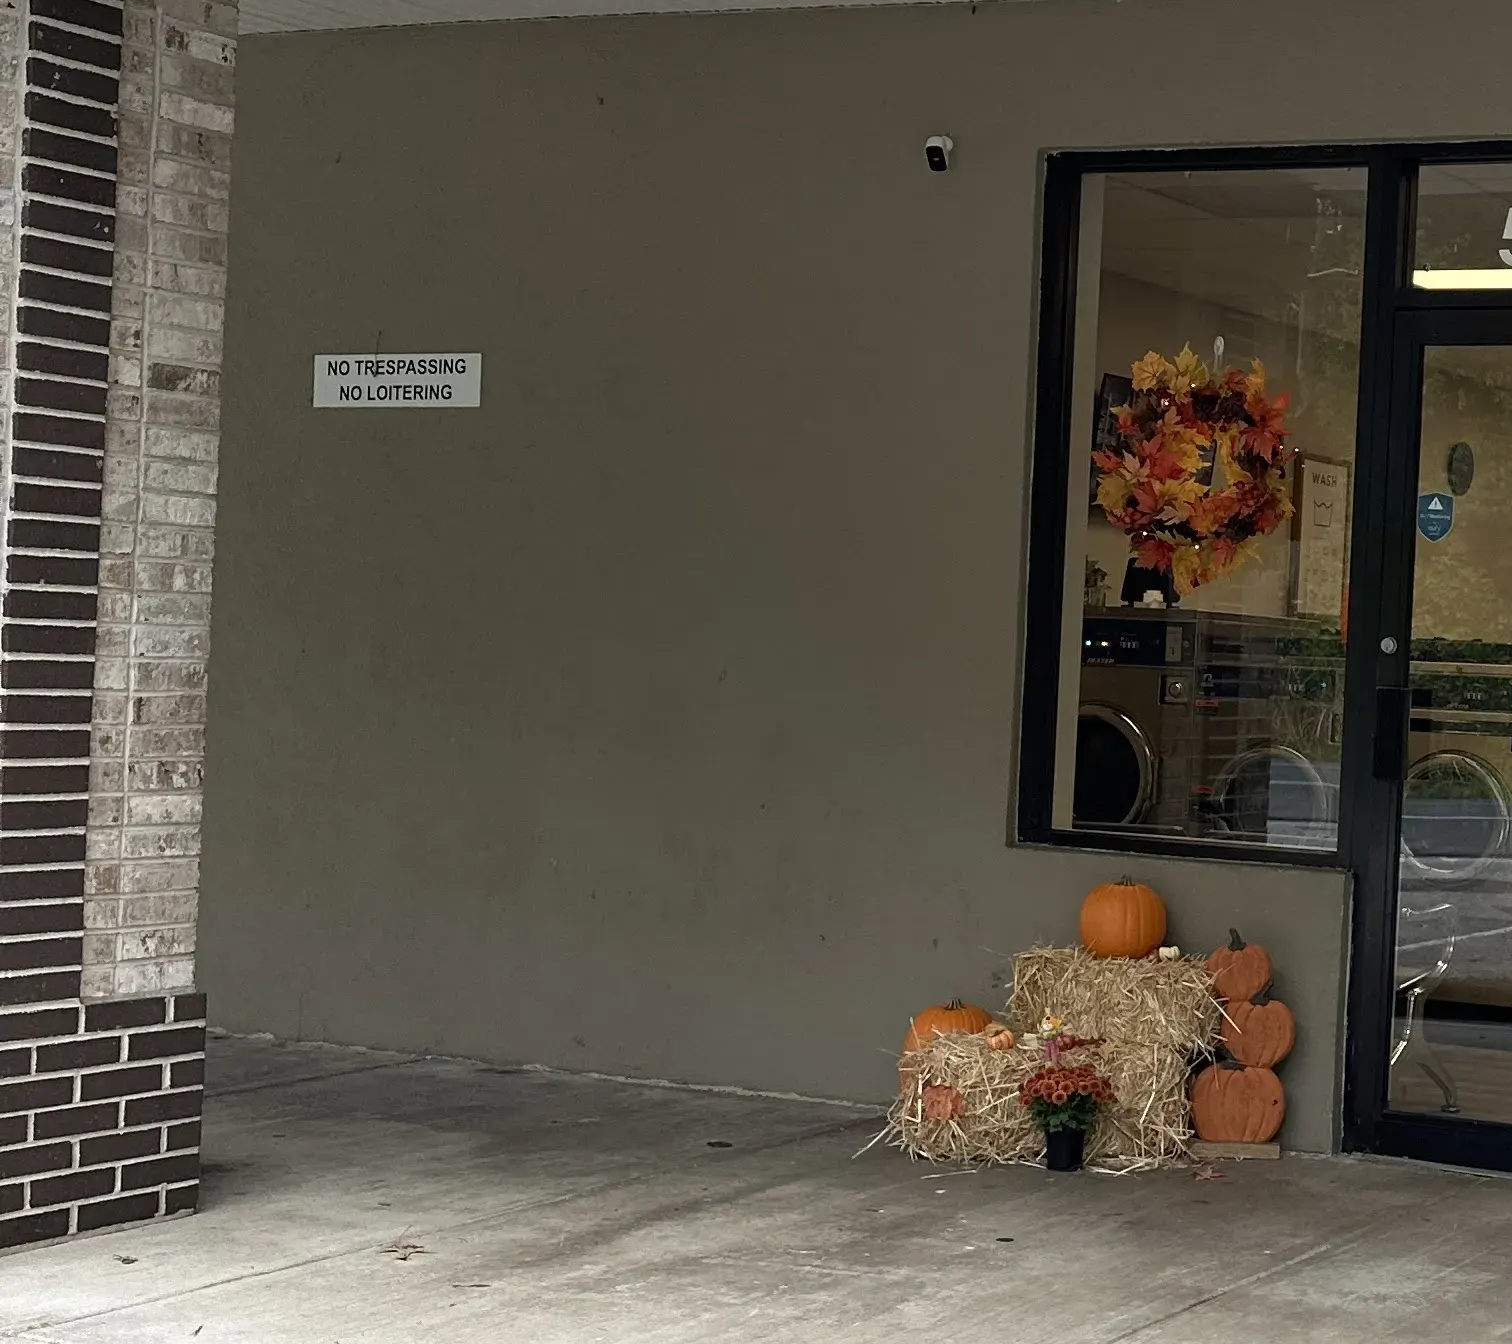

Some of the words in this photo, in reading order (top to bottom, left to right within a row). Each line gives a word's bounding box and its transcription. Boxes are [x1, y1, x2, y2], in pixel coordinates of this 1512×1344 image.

[327, 360, 350, 376] NO
[354, 358, 467, 376] TRESPASSING
[339, 385, 363, 401] NO
[367, 384, 453, 401] LOITERING
[1311, 472, 1337, 487] WASH
